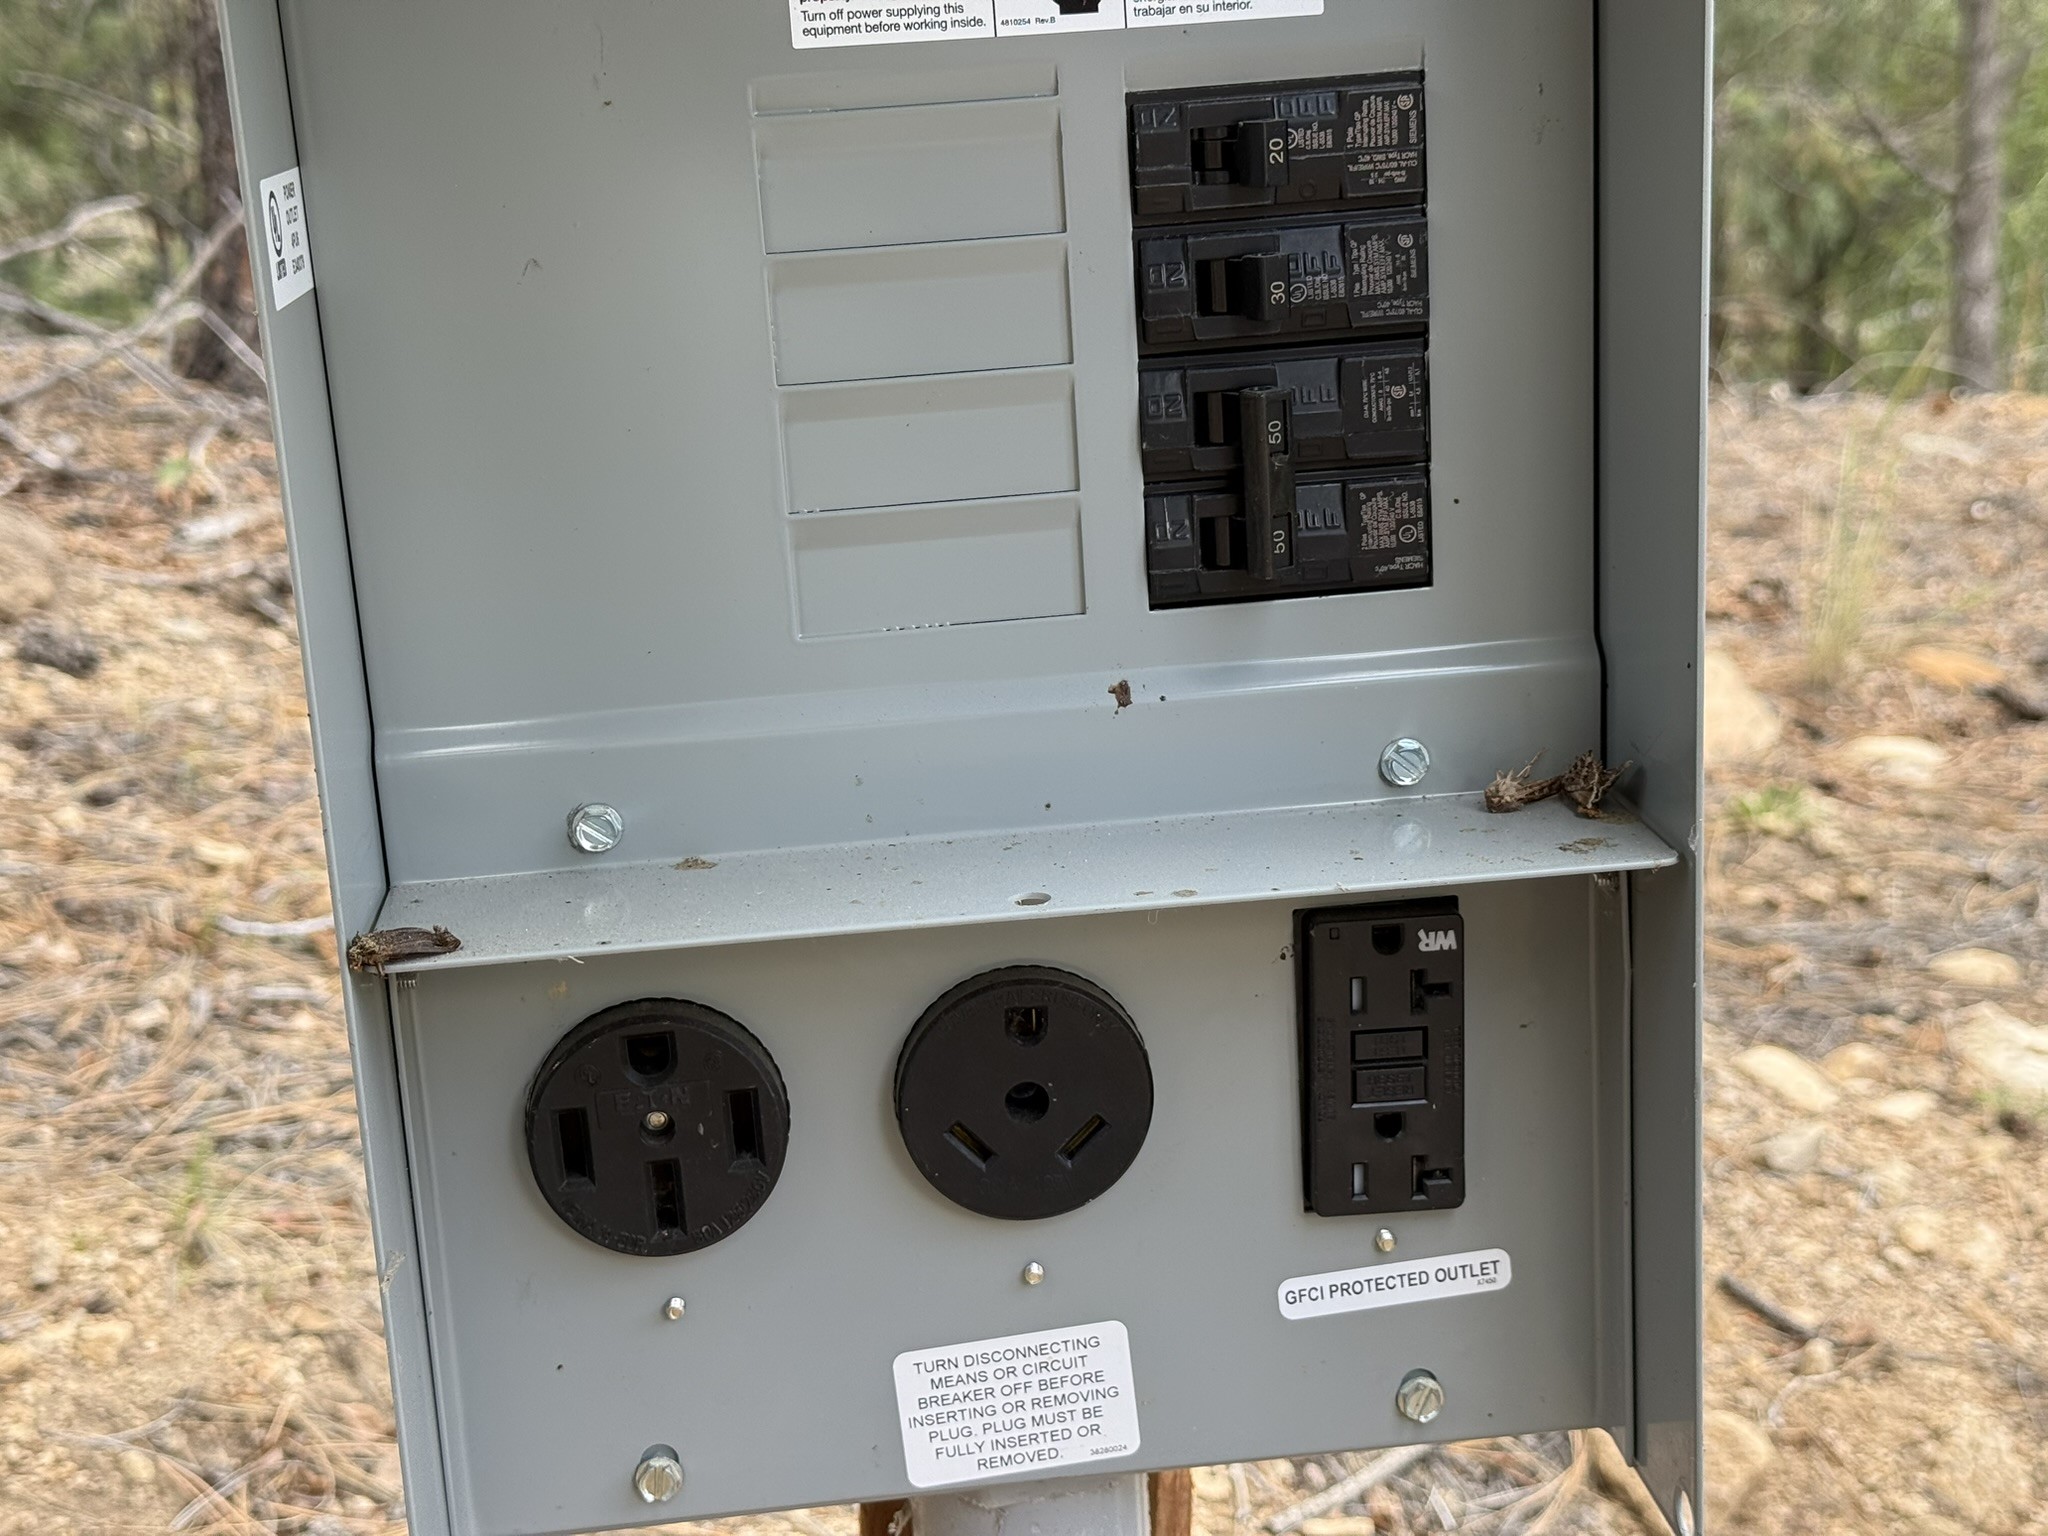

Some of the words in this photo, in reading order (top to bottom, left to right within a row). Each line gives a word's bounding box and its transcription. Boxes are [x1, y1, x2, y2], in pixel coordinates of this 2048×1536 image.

[800, 10, 826, 22] Turn
[829, 9, 844, 21] off
[847, 8, 884, 22] power
[886, 5, 940, 20] supplying
[943, 2, 964, 15] this
[1000, 17, 1031, 26] 4810254
[1034, 16, 1056, 25] Rev.B
[1133, 5, 1176, 18] trabajar
[1179, 6, 1193, 14] en
[1196, 5, 1209, 13] su
[1212, 1, 1253, 12] interior.
[802, 23, 863, 38] equipment
[865, 21, 901, 34] before
[903, 19, 948, 32] working
[950, 16, 986, 28] inside.
[1408, 110, 1417, 144] SIEMENS
[1269, 138, 1284, 164] 20
[1271, 281, 1285, 305] 30
[1268, 420, 1282, 445] 50
[1273, 530, 1286, 554] 50
[1416, 929, 1457, 951] WR
[1285, 1286, 1325, 1305] GFCI
[1329, 1270, 1430, 1298] PROTECTED
[1434, 1260, 1501, 1283] OUTLET
[913, 1357, 959, 1375] TURN
[964, 1335, 1101, 1368] DISCONNECTING
[930, 1371, 989, 1390] MEANS
[993, 1366, 1018, 1380] OR
[1022, 1355, 1088, 1376] CIRCUIT
[918, 1387, 996, 1410] BREAKER
[1000, 1381, 1033, 1397] OFF
[1038, 1370, 1105, 1392] BEFORE
[908, 1405, 997, 1429] INSERTING
[1001, 1399, 1026, 1414] OR
[1031, 1386, 1120, 1410] REMOVING
[929, 1426, 978, 1443] PLUG.
[982, 1417, 1026, 1435] PLUG
[1031, 1409, 1077, 1428] MUST
[1082, 1405, 1104, 1420] BE
[935, 1441, 986, 1460] FULLY
[990, 1428, 1072, 1451] INSERTED
[1076, 1423, 1102, 1439] OR
[977, 1447, 1064, 1471] REMOVED.
